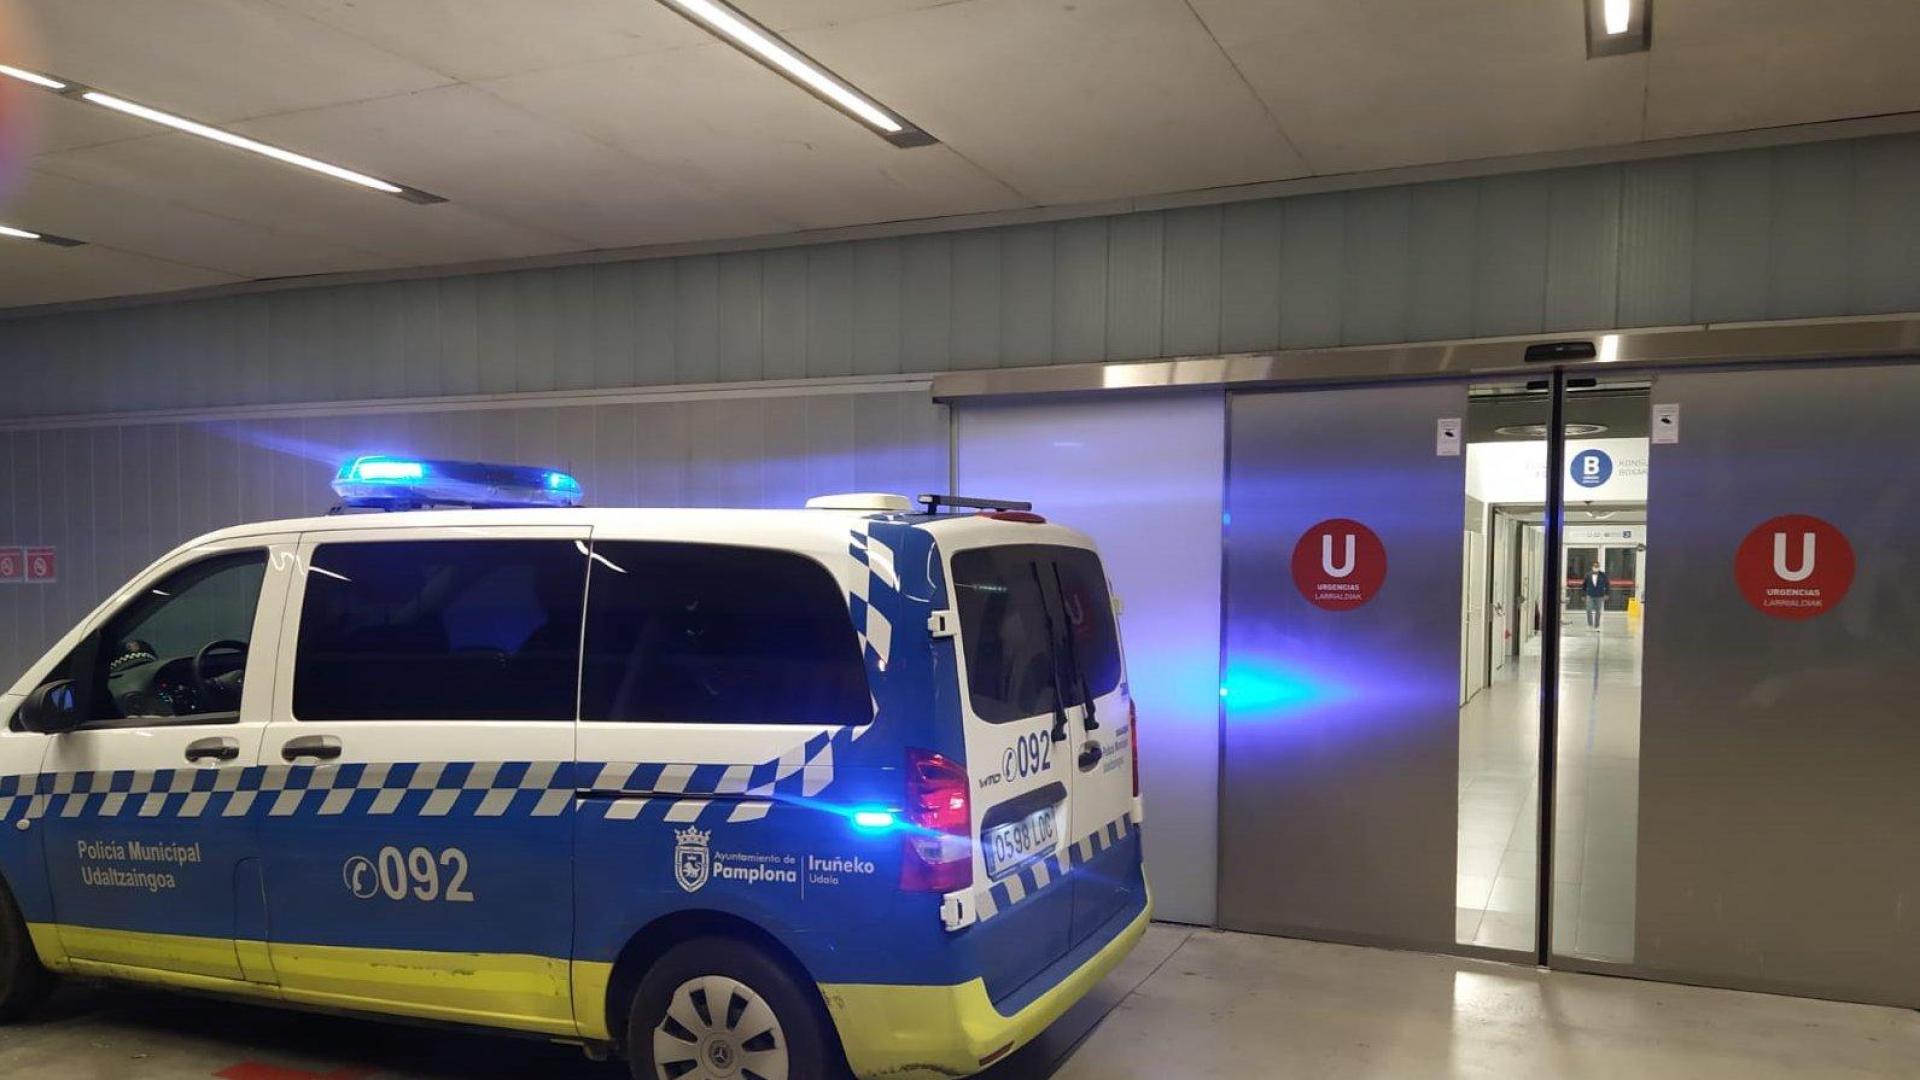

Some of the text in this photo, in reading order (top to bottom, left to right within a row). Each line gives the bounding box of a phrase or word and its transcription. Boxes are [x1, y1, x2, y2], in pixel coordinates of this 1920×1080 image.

[1584, 456, 1600, 475] B
[1322, 534, 1355, 578] U
[1774, 532, 1815, 581] U
[1317, 583, 1360, 591] URGENCIAS
[1766, 588, 1820, 596] URGENCIAS
[1017, 730, 1051, 778] 092
[77, 840, 201, 868] Policía Municipal
[713, 851, 796, 865] Ayuntamiento de
[995, 830, 1031, 863] 0598
[378, 846, 475, 902] 092
[712, 861, 797, 885] Pamplona
[808, 855, 875, 874] Iruñeko
[81, 867, 176, 893] Udaltzaingoa
[809, 873, 840, 886] Udala
